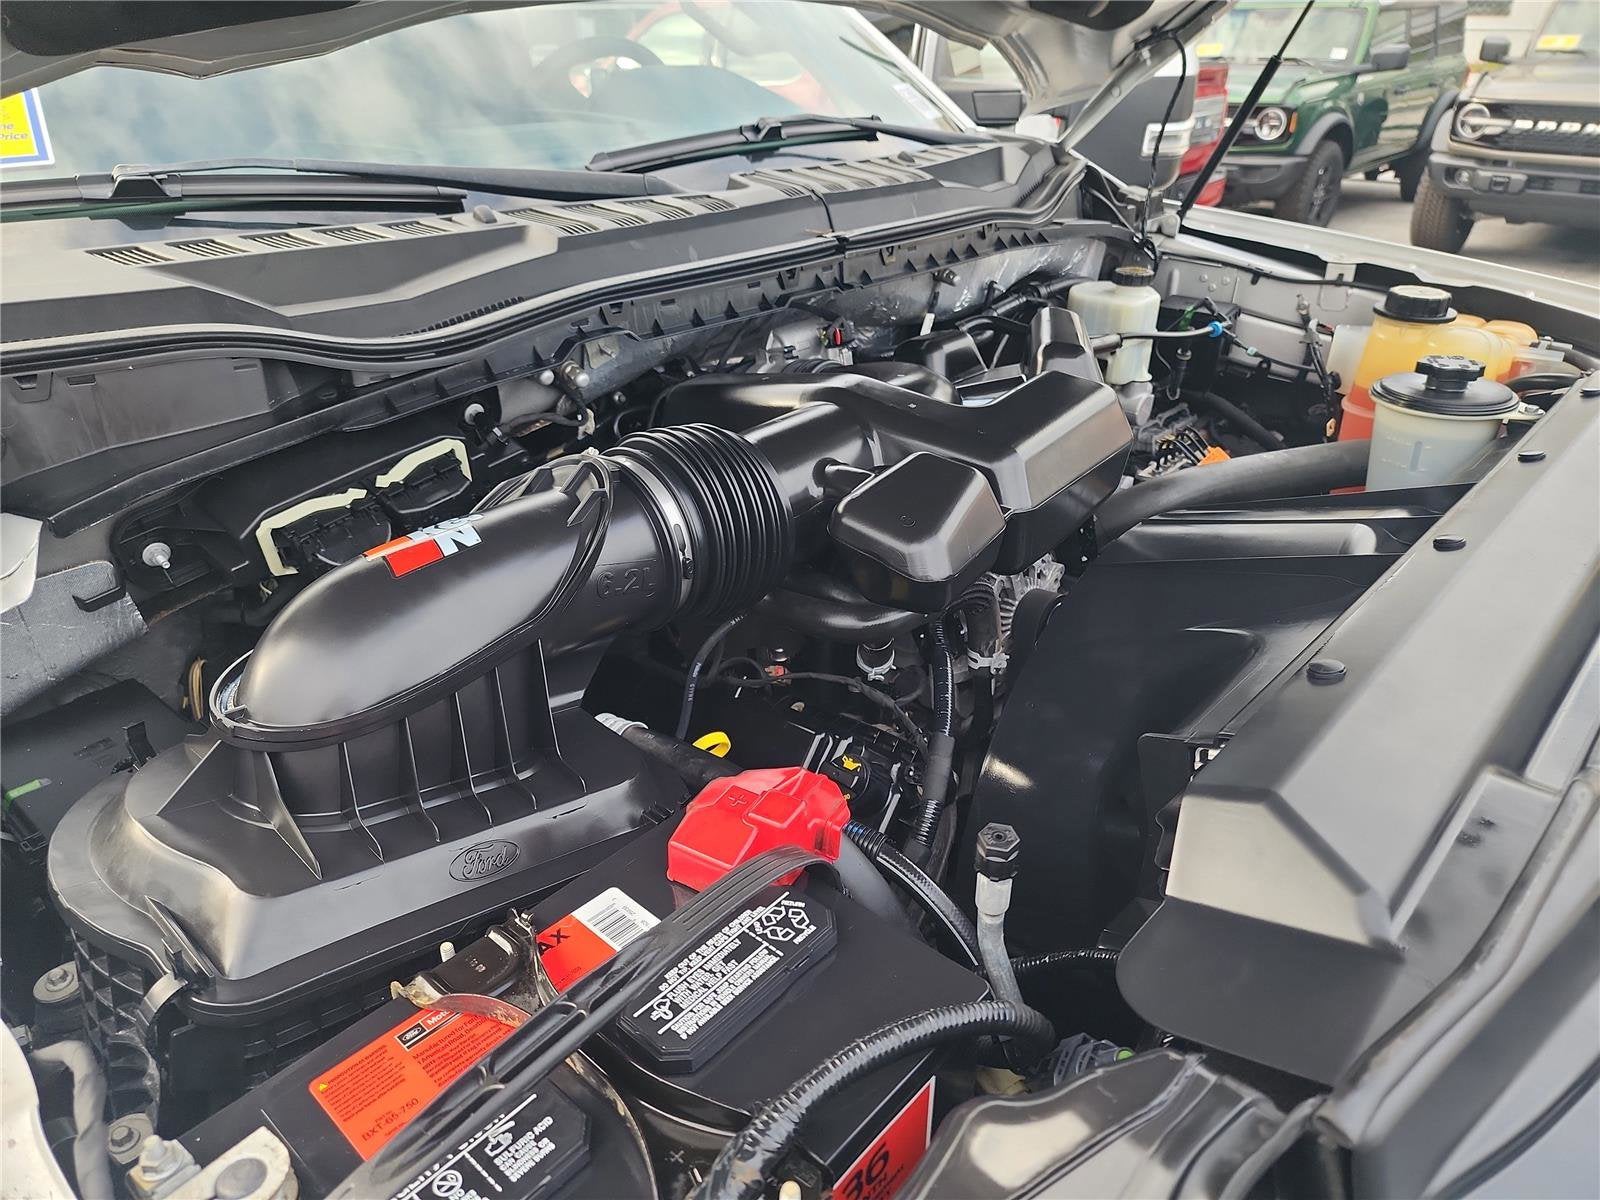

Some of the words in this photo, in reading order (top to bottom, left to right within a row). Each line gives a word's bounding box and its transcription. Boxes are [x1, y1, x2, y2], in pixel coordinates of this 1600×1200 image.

[462, 843, 510, 880] Ford
[666, 981, 689, 999] FLUSH
[685, 967, 705, 983] EYES
[701, 938, 741, 970] IMMEDIATELY
[672, 988, 692, 1004] WITH
[710, 960, 726, 972] GET
[678, 985, 708, 1009] MEDICAL
[705, 972, 723, 986] HELP
[720, 959, 738, 973] FAST
[492, 1130, 535, 1166] SULFURIC
[532, 1117, 553, 1135] ACID
